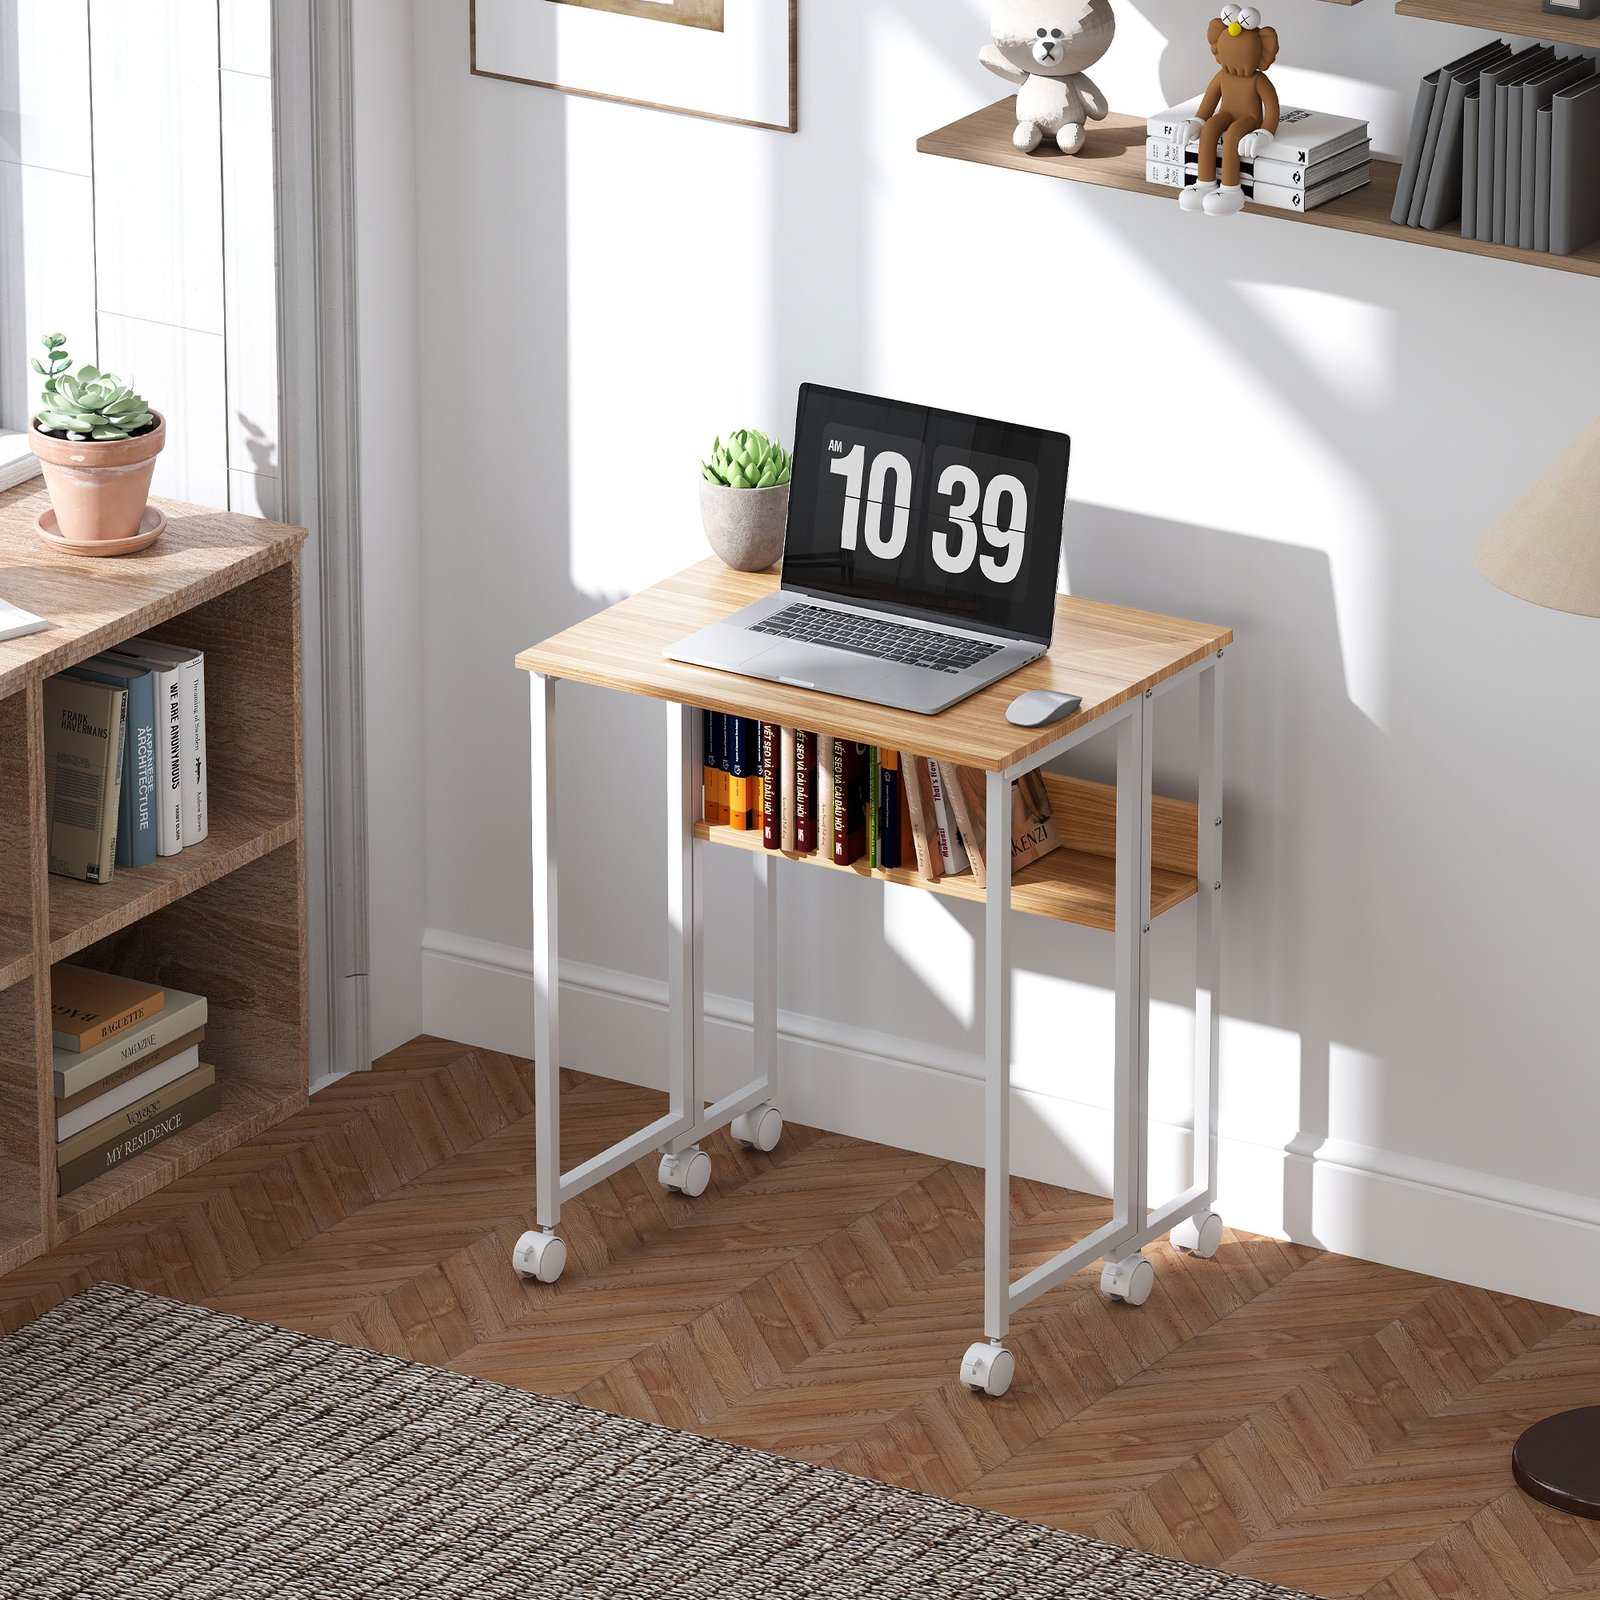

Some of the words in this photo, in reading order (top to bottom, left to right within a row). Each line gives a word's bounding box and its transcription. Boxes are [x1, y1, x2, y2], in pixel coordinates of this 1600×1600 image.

[828, 440, 843, 453] AM
[829, 444, 913, 560] 10
[931, 464, 1028, 584] 39
[170, 682, 178, 701] WE
[62, 709, 88, 724] FRANK
[170, 702, 179, 723] ARE
[61, 721, 108, 739] HAVERMANS
[145, 724, 154, 794] JAPANESE
[171, 724, 180, 790] ANONYMOUS
[137, 727, 149, 831] ARCHITECTURE
[930, 780, 941, 802] That's
[101, 1008, 144, 1037] BAGUETTE
[121, 1034, 157, 1060] MAGAZINE
[126, 1100, 160, 1125] Voyage
[106, 1144, 124, 1166] MY
[124, 1112, 182, 1156] RESIDENCE
